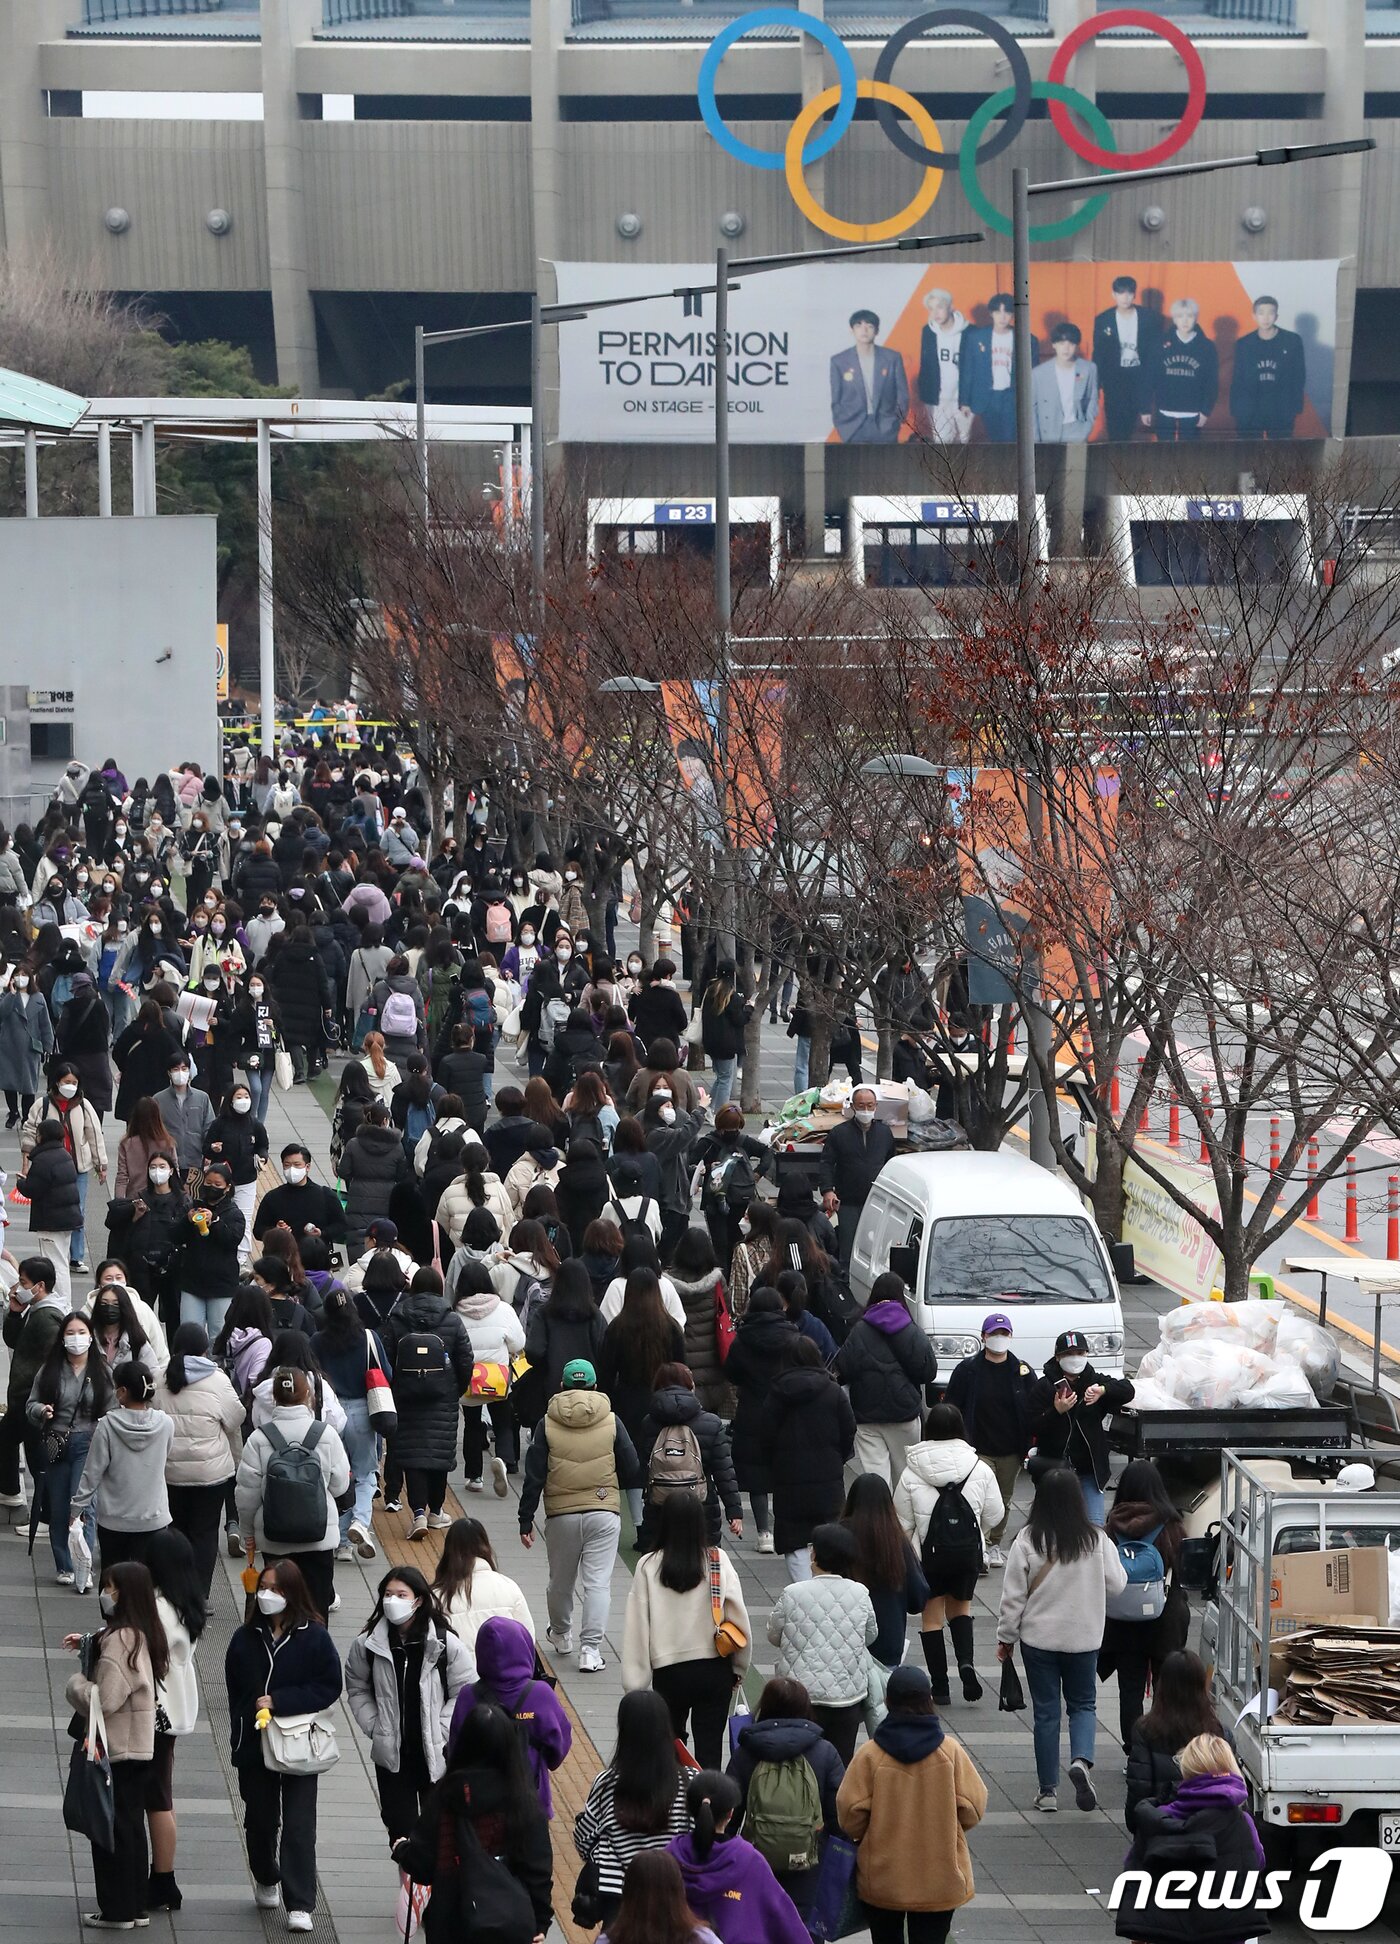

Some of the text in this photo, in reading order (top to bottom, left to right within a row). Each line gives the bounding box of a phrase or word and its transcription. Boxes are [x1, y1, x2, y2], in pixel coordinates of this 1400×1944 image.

[599, 360, 789, 386] TO DANCE
[623, 400, 647, 413] ON
[651, 400, 703, 413] STAGE
[727, 400, 764, 413] EOUL
[684, 505, 707, 520] 23
[1217, 503, 1236, 517] 21
